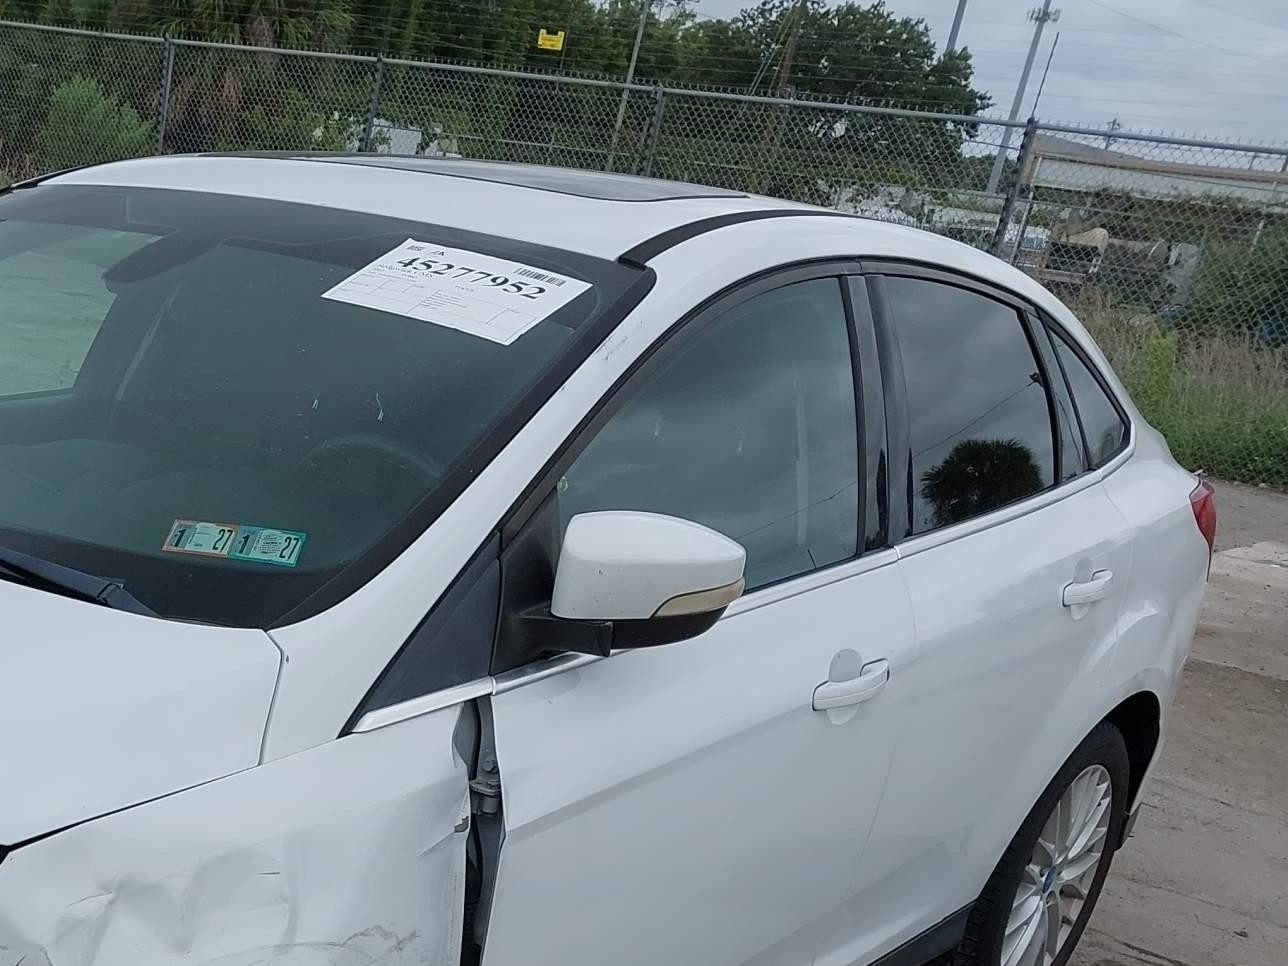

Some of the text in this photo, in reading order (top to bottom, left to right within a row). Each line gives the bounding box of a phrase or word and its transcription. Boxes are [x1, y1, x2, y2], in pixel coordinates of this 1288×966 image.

[395, 256, 547, 300] 45277952
[213, 528, 234, 552] 27
[279, 536, 299, 560] 27
